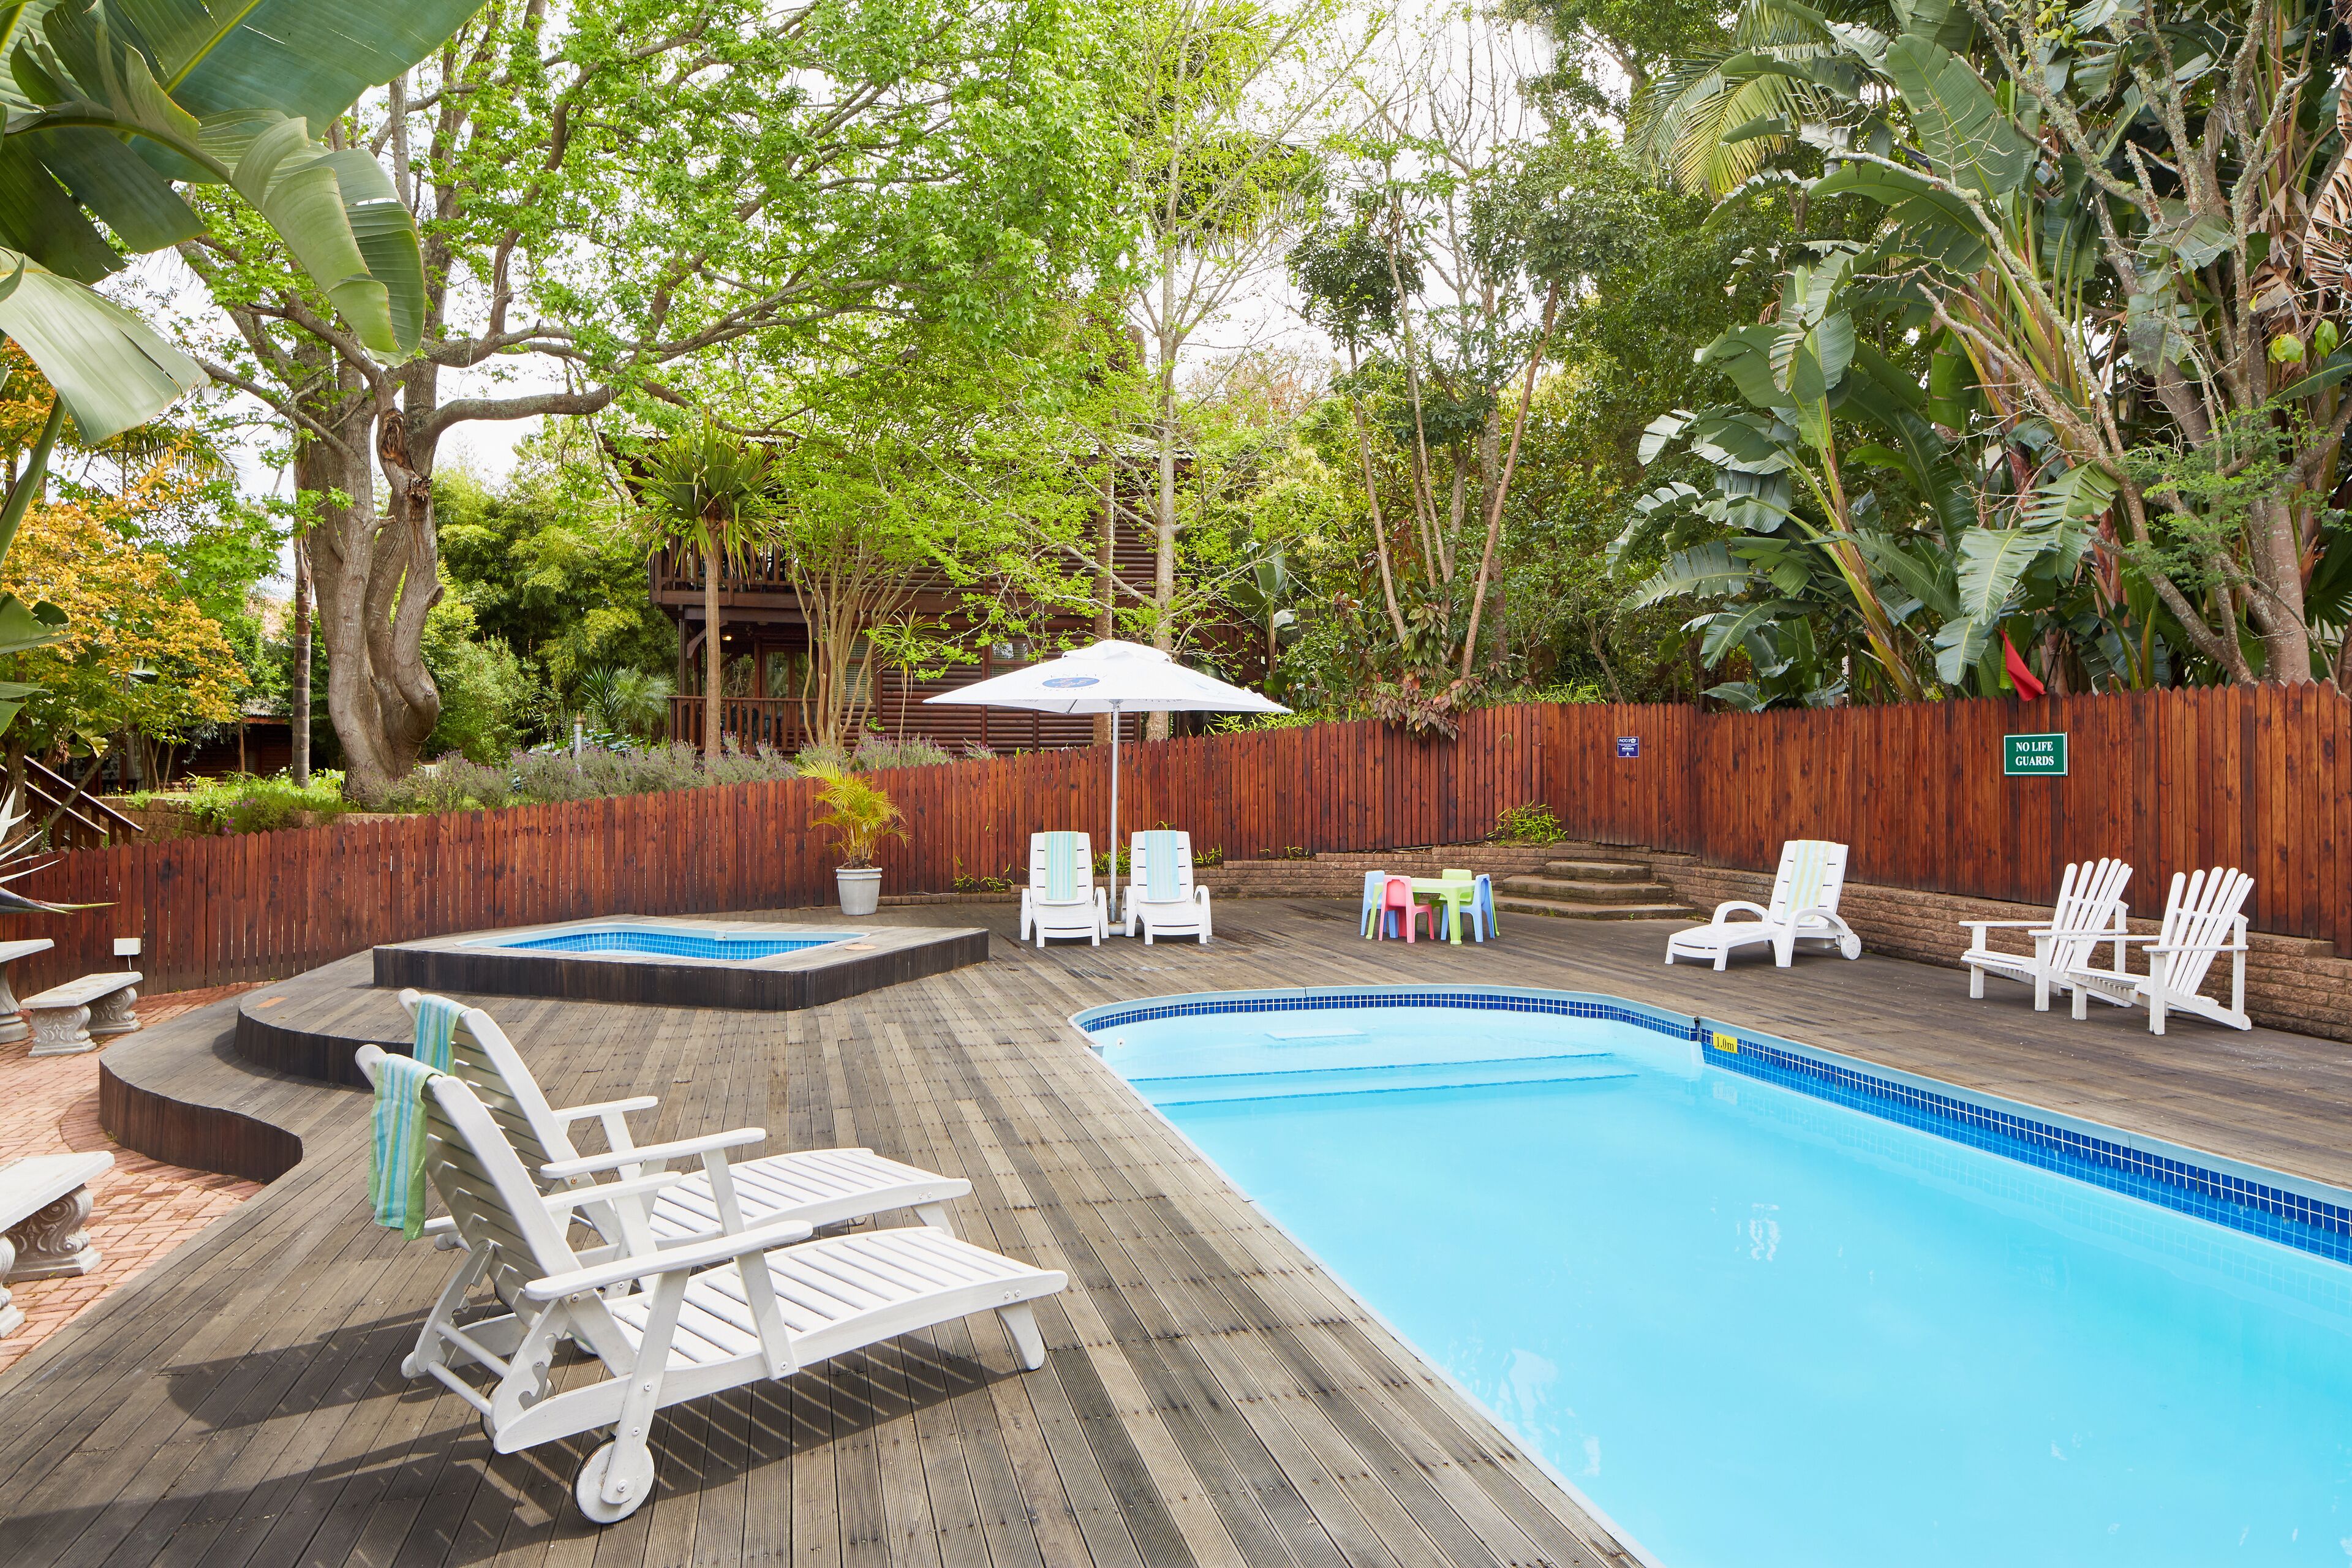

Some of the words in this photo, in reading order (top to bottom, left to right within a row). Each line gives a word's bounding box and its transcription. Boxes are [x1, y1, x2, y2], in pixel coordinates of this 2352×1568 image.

[2016, 742, 2030, 752] NO
[2032, 741, 2053, 752] LIFE
[2015, 756, 2054, 766] GUARDS
[1716, 1036, 1734, 1051] 1.0m
